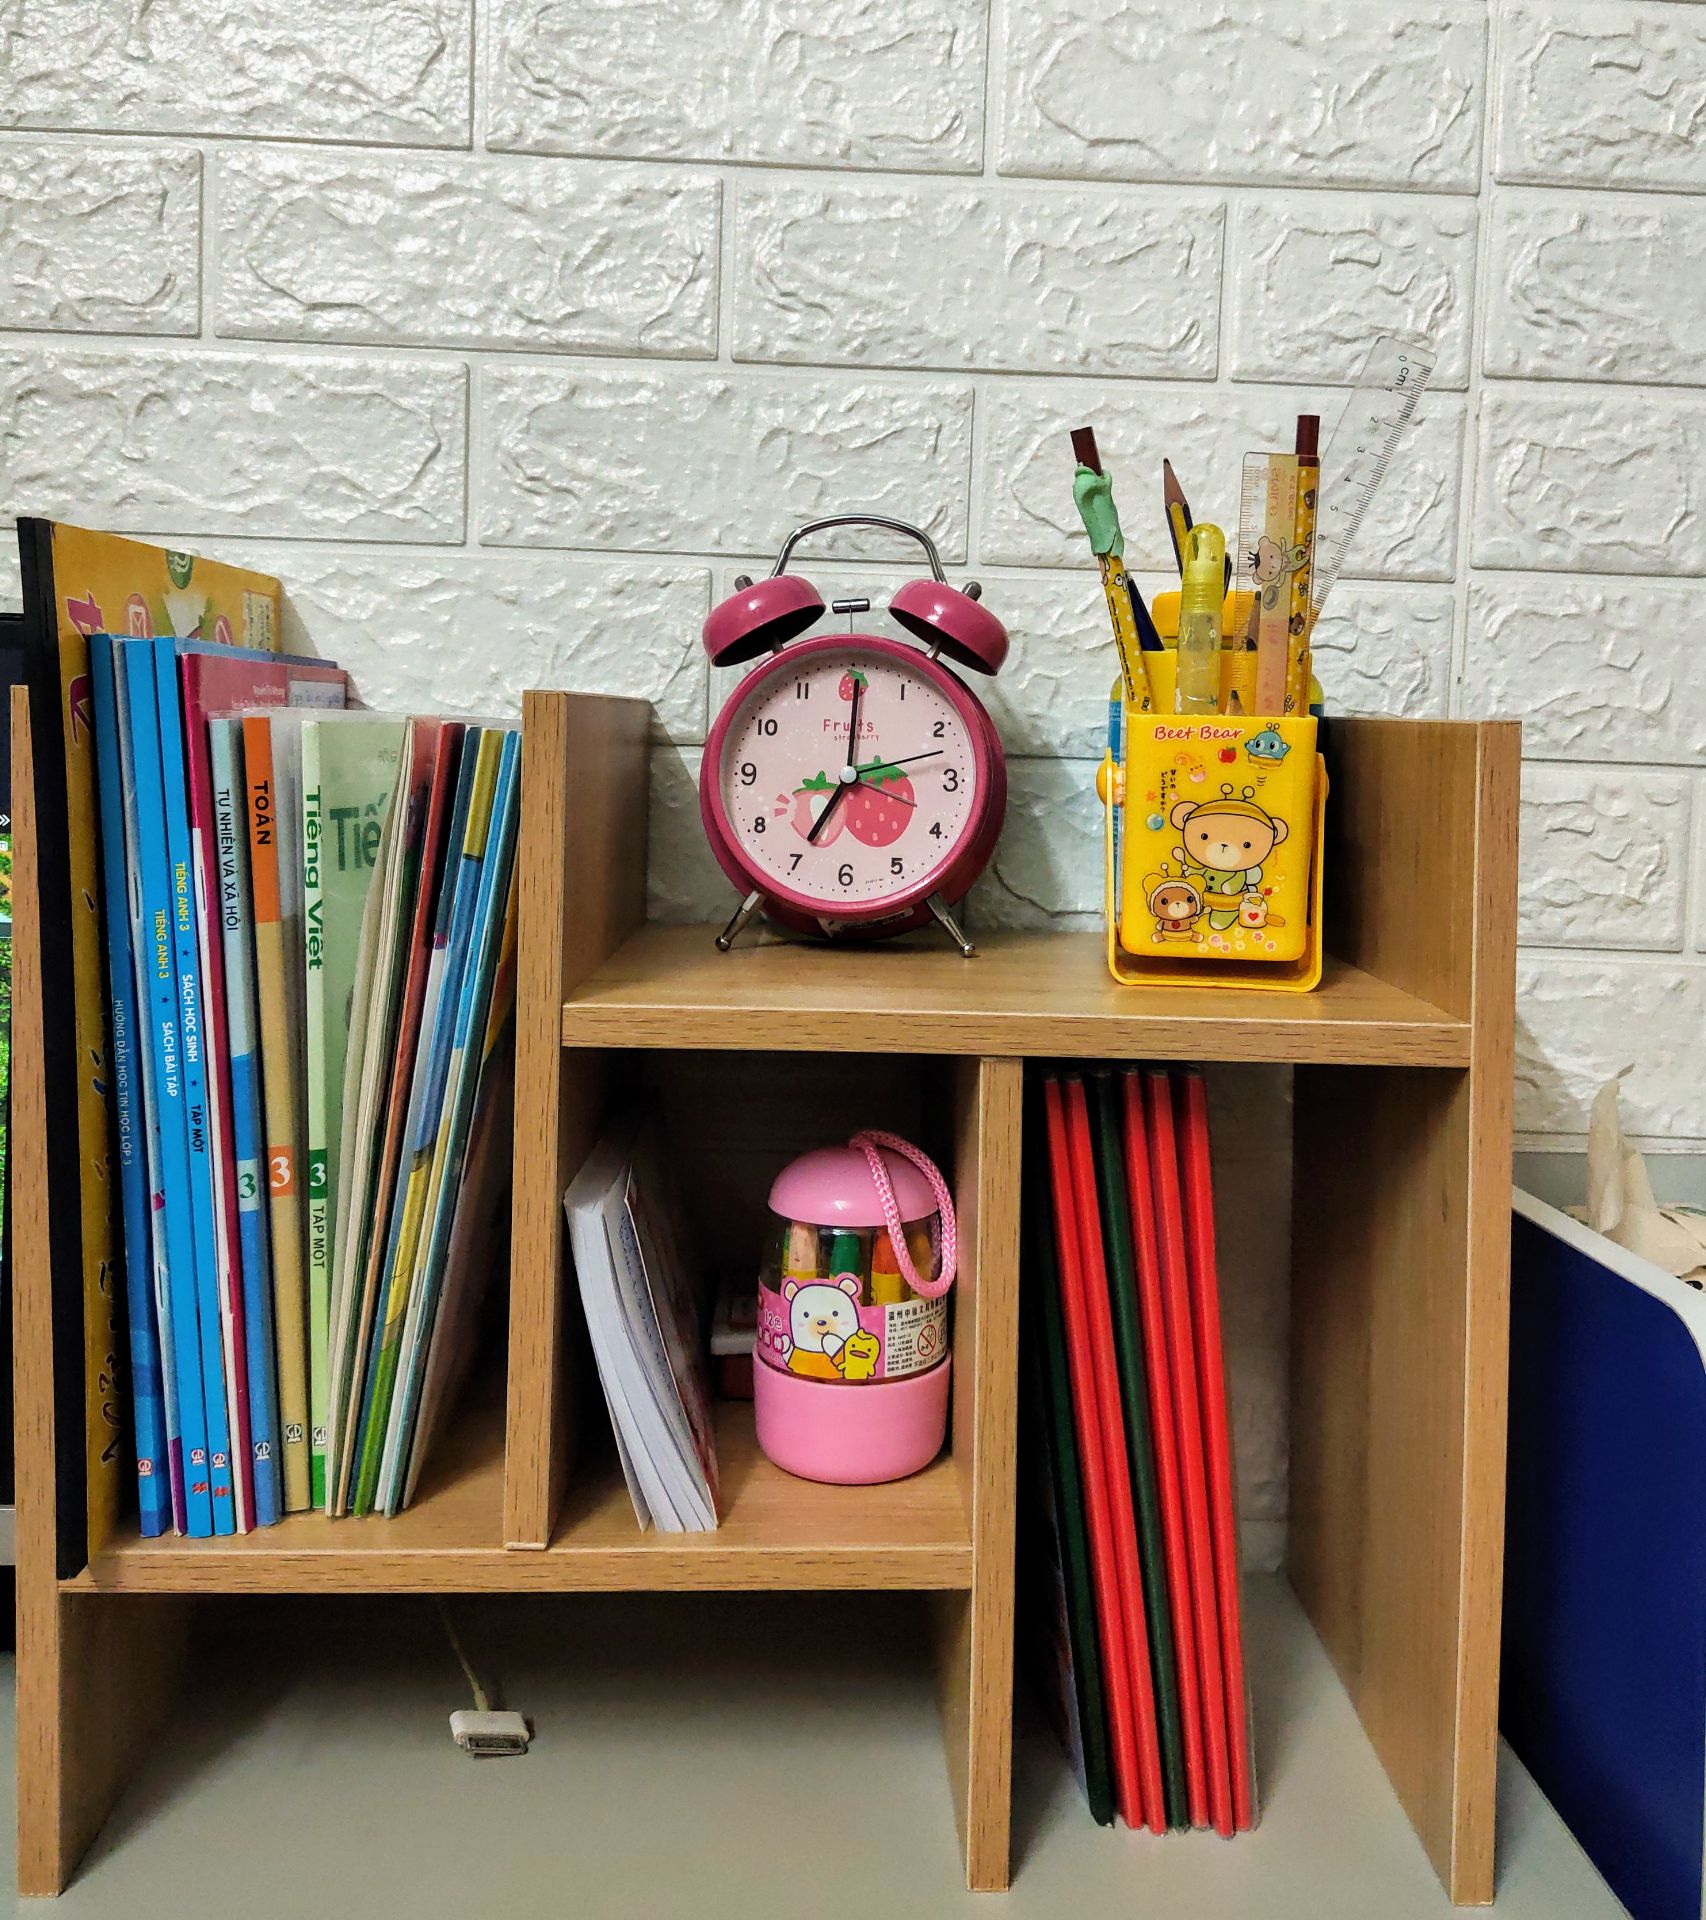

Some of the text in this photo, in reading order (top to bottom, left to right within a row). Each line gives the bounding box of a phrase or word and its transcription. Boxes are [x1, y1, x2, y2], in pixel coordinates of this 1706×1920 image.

[1395, 367, 1409, 386] cm
[796, 682, 809, 700] 11
[900, 683, 905, 701] 1
[757, 718, 778, 736] 10
[823, 718, 874, 733] Fruts
[932, 720, 945, 738] 2
[1154, 725, 1243, 740] Beet Bear
[740, 762, 757, 786] 9
[942, 768, 959, 792] 3
[254, 780, 274, 845] TOÁN
[753, 816, 766, 834] 8
[928, 822, 942, 839] 4
[216, 788, 241, 931] TỰ NHIÊN VÀ XÃ HỘI
[789, 853, 803, 871] 7
[890, 857, 904, 875] 5
[175, 861, 190, 894] TIẾNG
[838, 863, 854, 886] 6
[178, 896, 189, 922] ANH
[154, 908, 170, 942] TIẾNG
[179, 924, 190, 932] 3
[304, 899, 324, 970] Việt
[156, 944, 168, 970] ANH
[182, 974, 196, 1005] SÁCH
[183, 1007, 196, 1033] HỌC
[162, 1021, 175, 1053] SÁCH
[186, 1036, 198, 1062] SINH
[164, 1055, 177, 1073] BÀI
[164, 1075, 178, 1097] TẬP
[119, 1090, 129, 1108] TIN
[118, 1110, 130, 1133] HỌC
[191, 1128, 204, 1153] MỘT
[271, 1156, 291, 1188] 3
[310, 1162, 327, 1187] 3
[239, 1173, 257, 1199] 3
